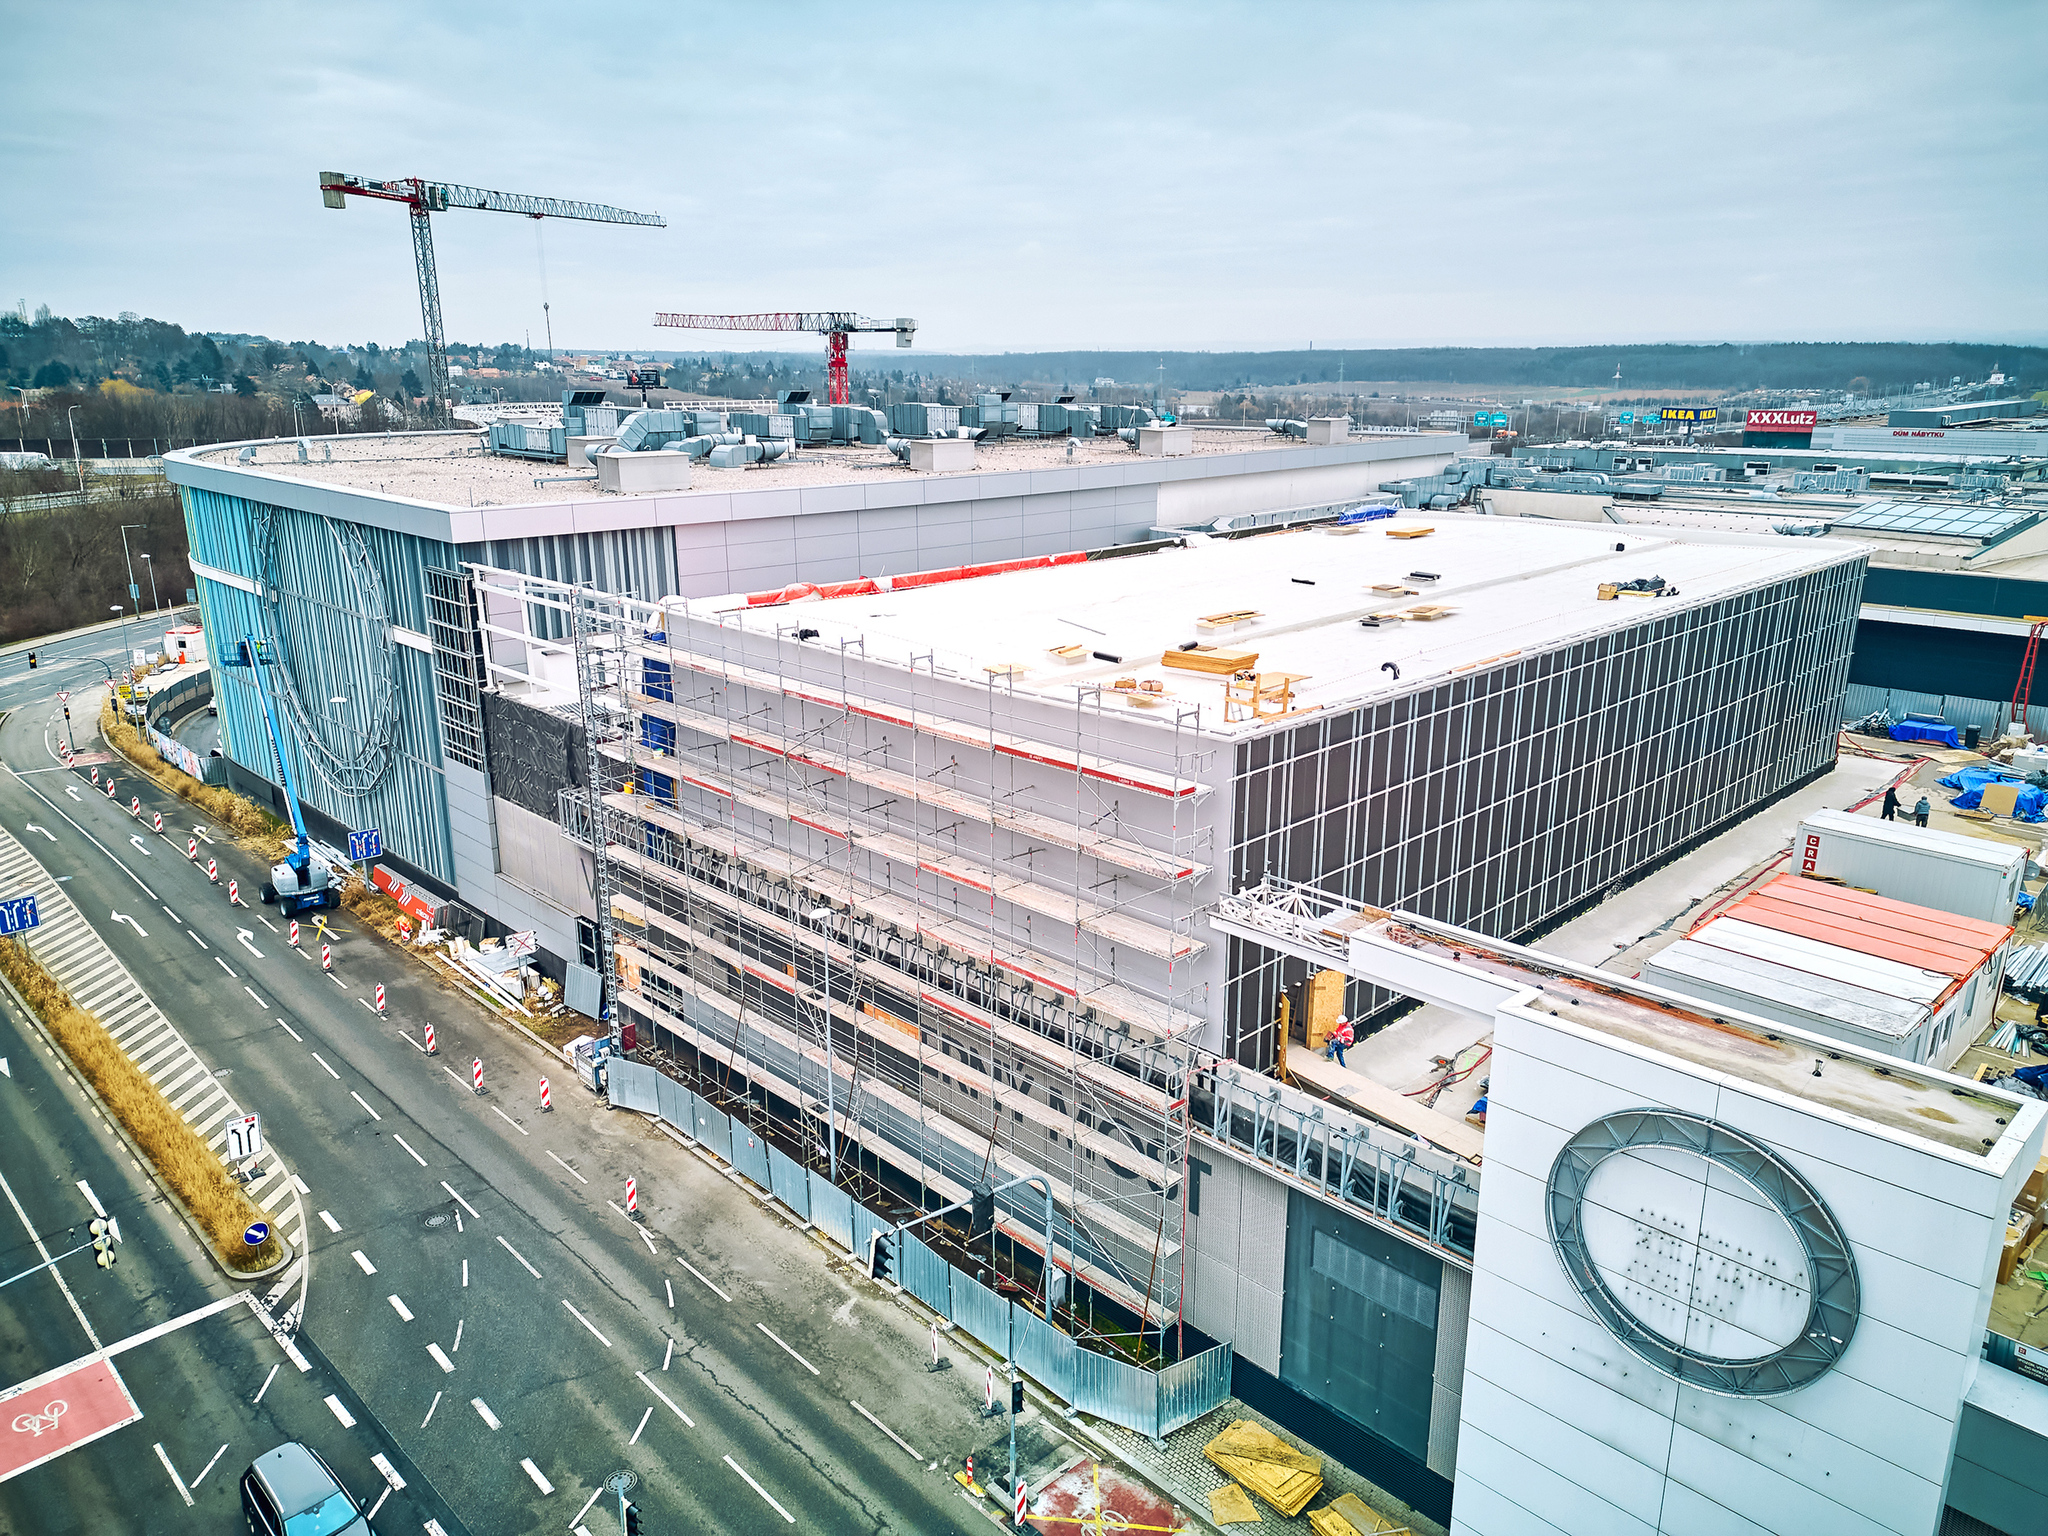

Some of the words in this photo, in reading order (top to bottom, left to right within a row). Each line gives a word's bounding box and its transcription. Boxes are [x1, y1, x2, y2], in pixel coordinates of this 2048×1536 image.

[1662, 409, 1695, 420] IKEA
[1748, 412, 1815, 425] XXXLutz
[1049, 1086, 1213, 1217] MOST
